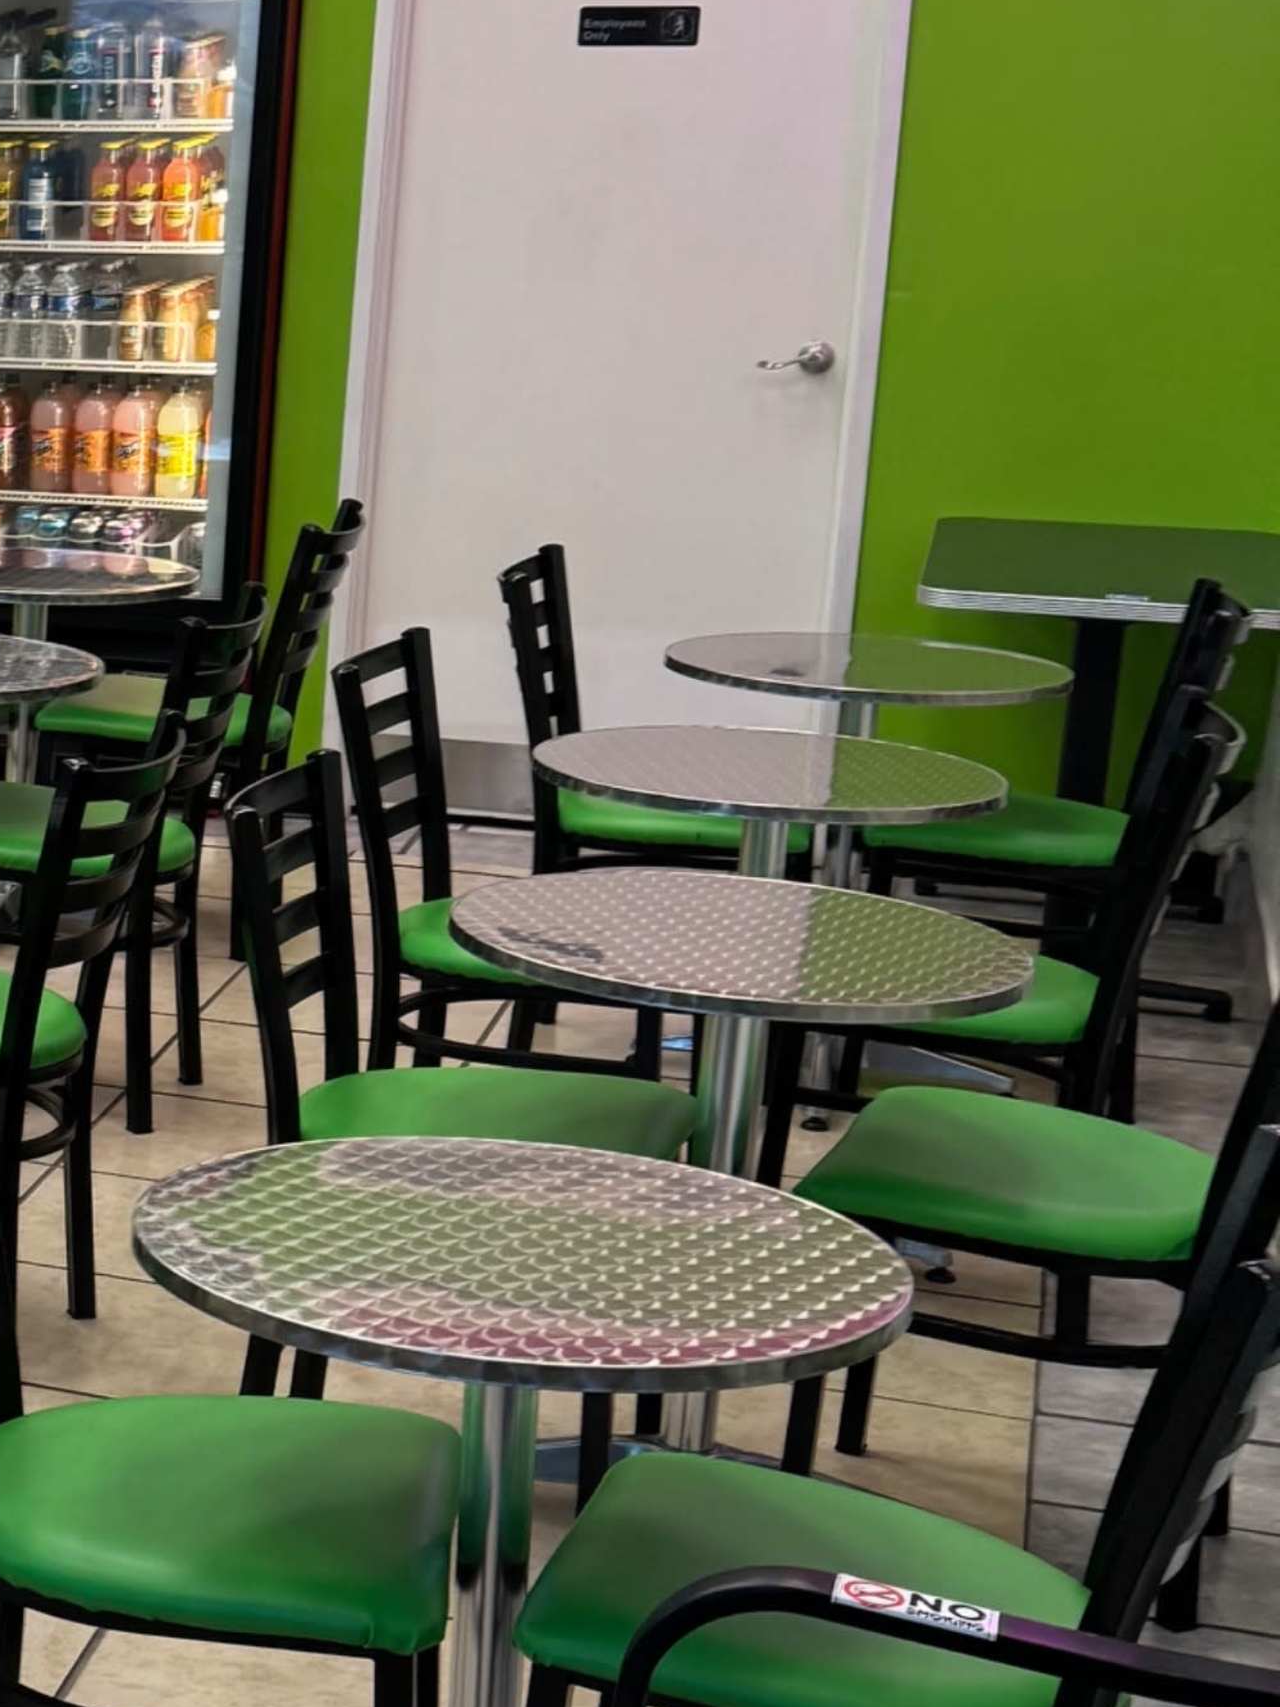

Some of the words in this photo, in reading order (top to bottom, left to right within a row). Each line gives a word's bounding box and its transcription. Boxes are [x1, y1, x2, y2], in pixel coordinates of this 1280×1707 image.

[583, 18, 647, 30] Employees
[583, 30, 611, 43] Only
[911, 1592, 987, 1622] NO
